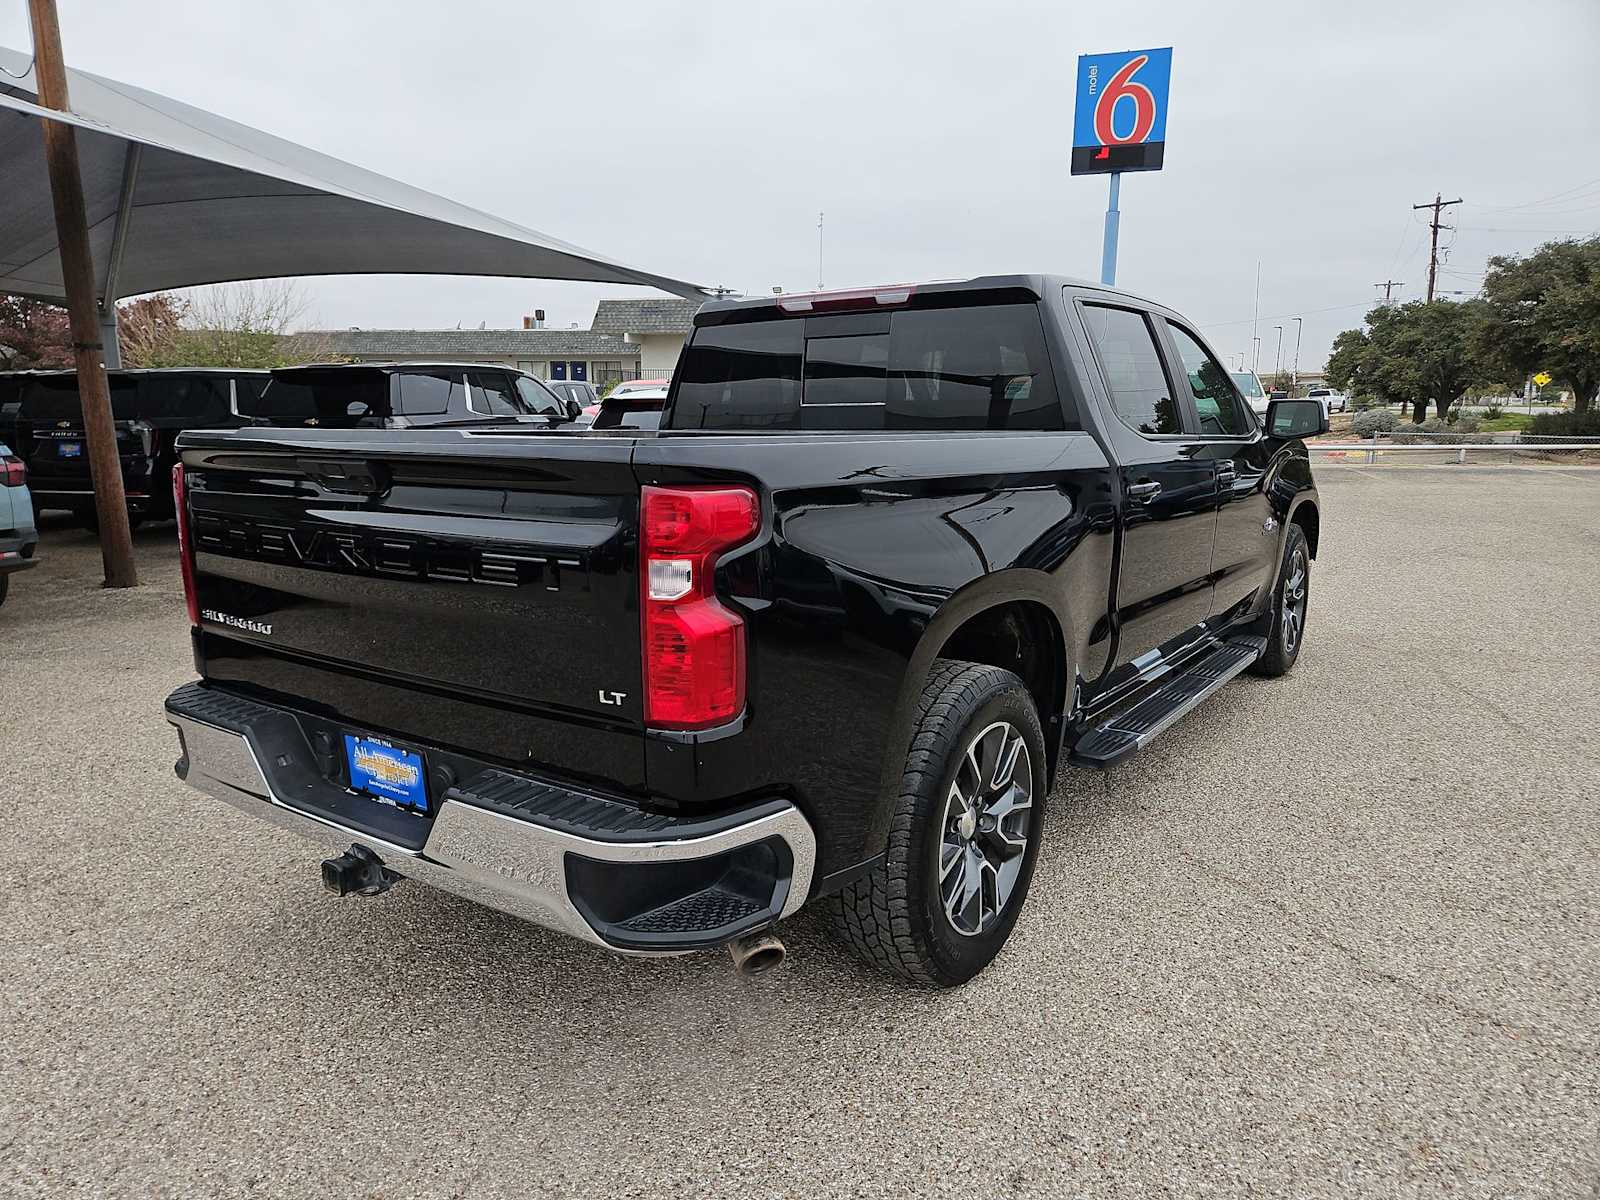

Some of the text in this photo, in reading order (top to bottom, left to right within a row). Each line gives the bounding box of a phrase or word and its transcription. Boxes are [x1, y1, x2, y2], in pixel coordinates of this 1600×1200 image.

[1088, 65, 1098, 95] motel
[1093, 54, 1156, 146] 6
[599, 690, 627, 706] LT
